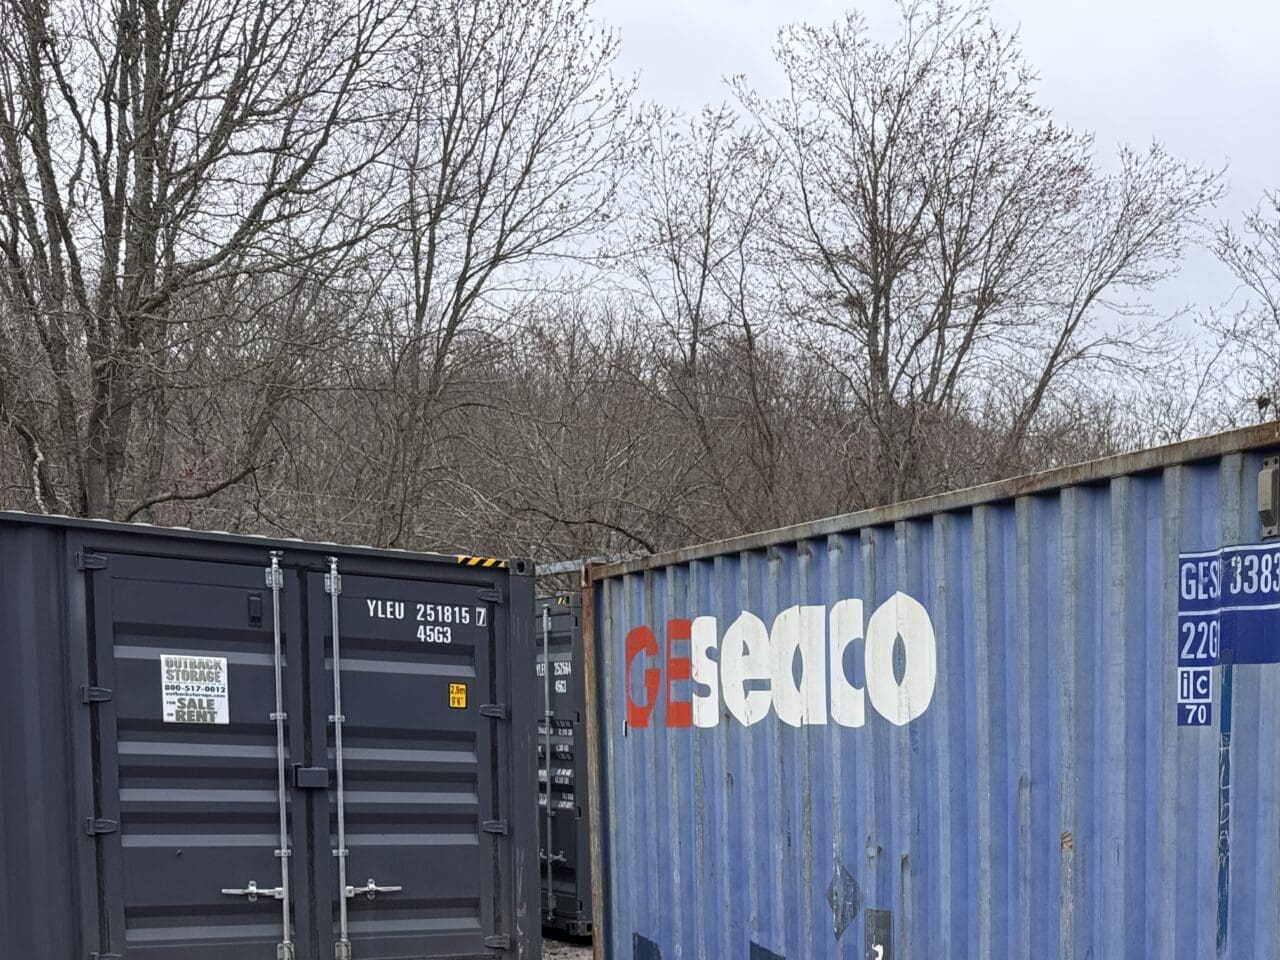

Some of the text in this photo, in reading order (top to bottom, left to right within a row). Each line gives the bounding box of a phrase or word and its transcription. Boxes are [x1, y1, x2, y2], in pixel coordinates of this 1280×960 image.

[1181, 560, 1221, 600] GES
[367, 599, 405, 619] YLEU
[416, 604, 470, 624] 251815
[416, 625, 452, 643] 45G3
[165, 656, 222, 671] OUTBACK
[166, 669, 221, 682] STORAGE
[165, 685, 225, 693] 800-517-0012
[177, 698, 215, 710] SALE
[175, 710, 217, 722] RENT
[1185, 704, 1207, 724] 70
